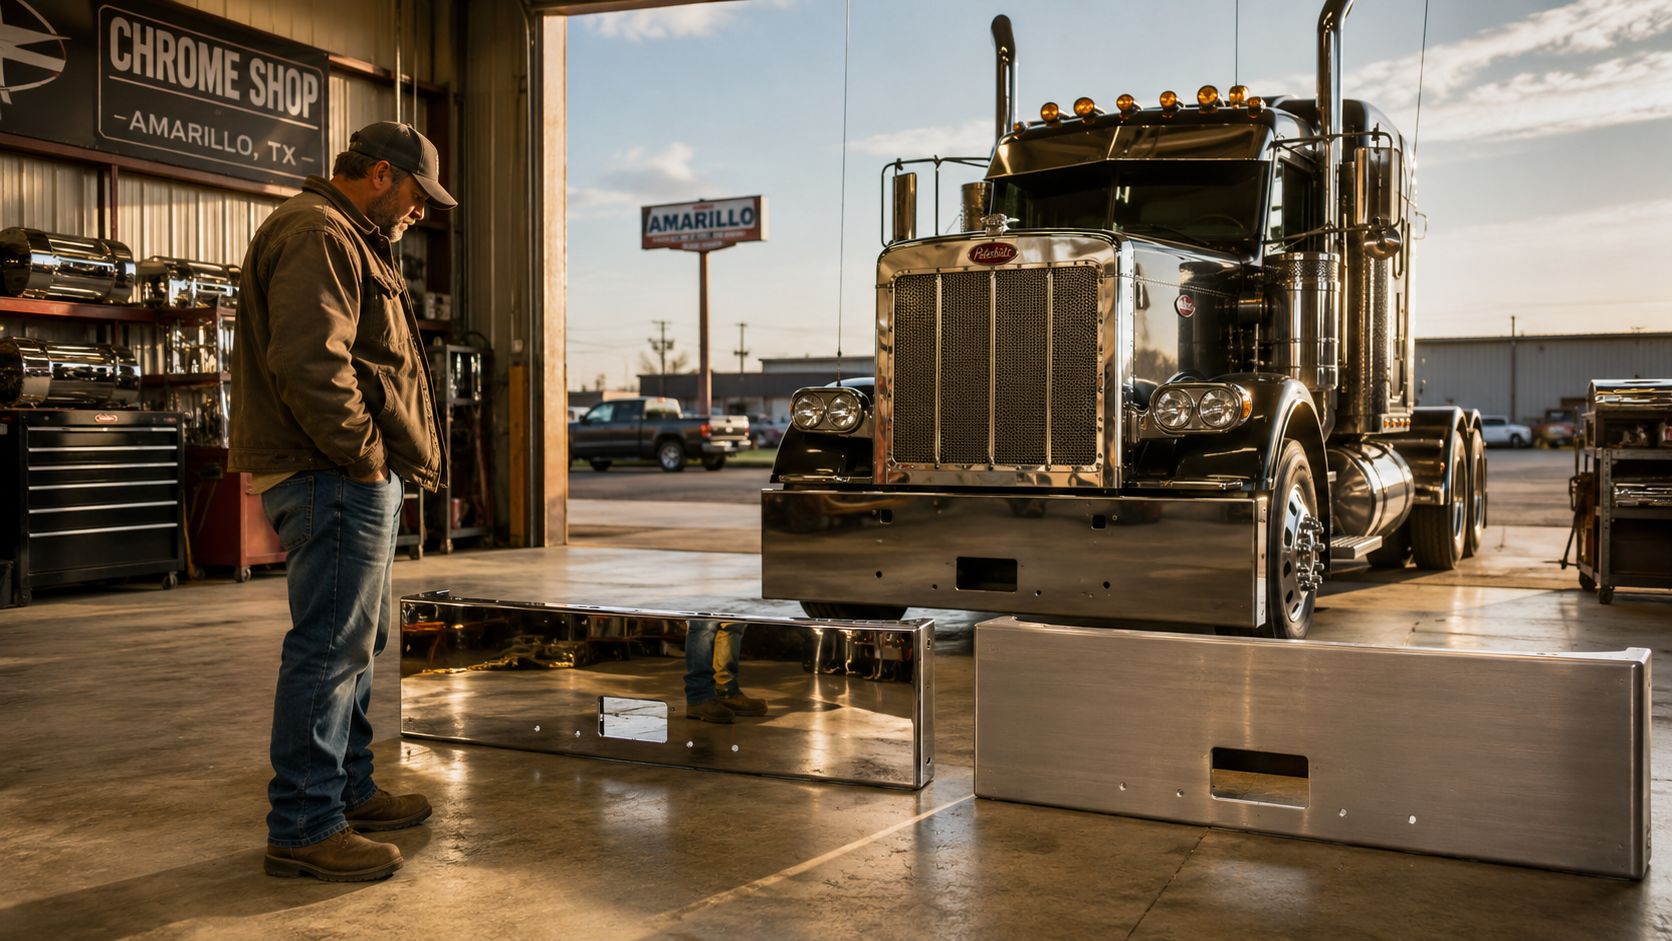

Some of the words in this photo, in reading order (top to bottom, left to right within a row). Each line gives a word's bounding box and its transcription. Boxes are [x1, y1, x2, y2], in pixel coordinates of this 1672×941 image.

[110, 16, 240, 100] CHROME
[249, 57, 318, 118] SHOP
[649, 207, 754, 233] AMARILLO
